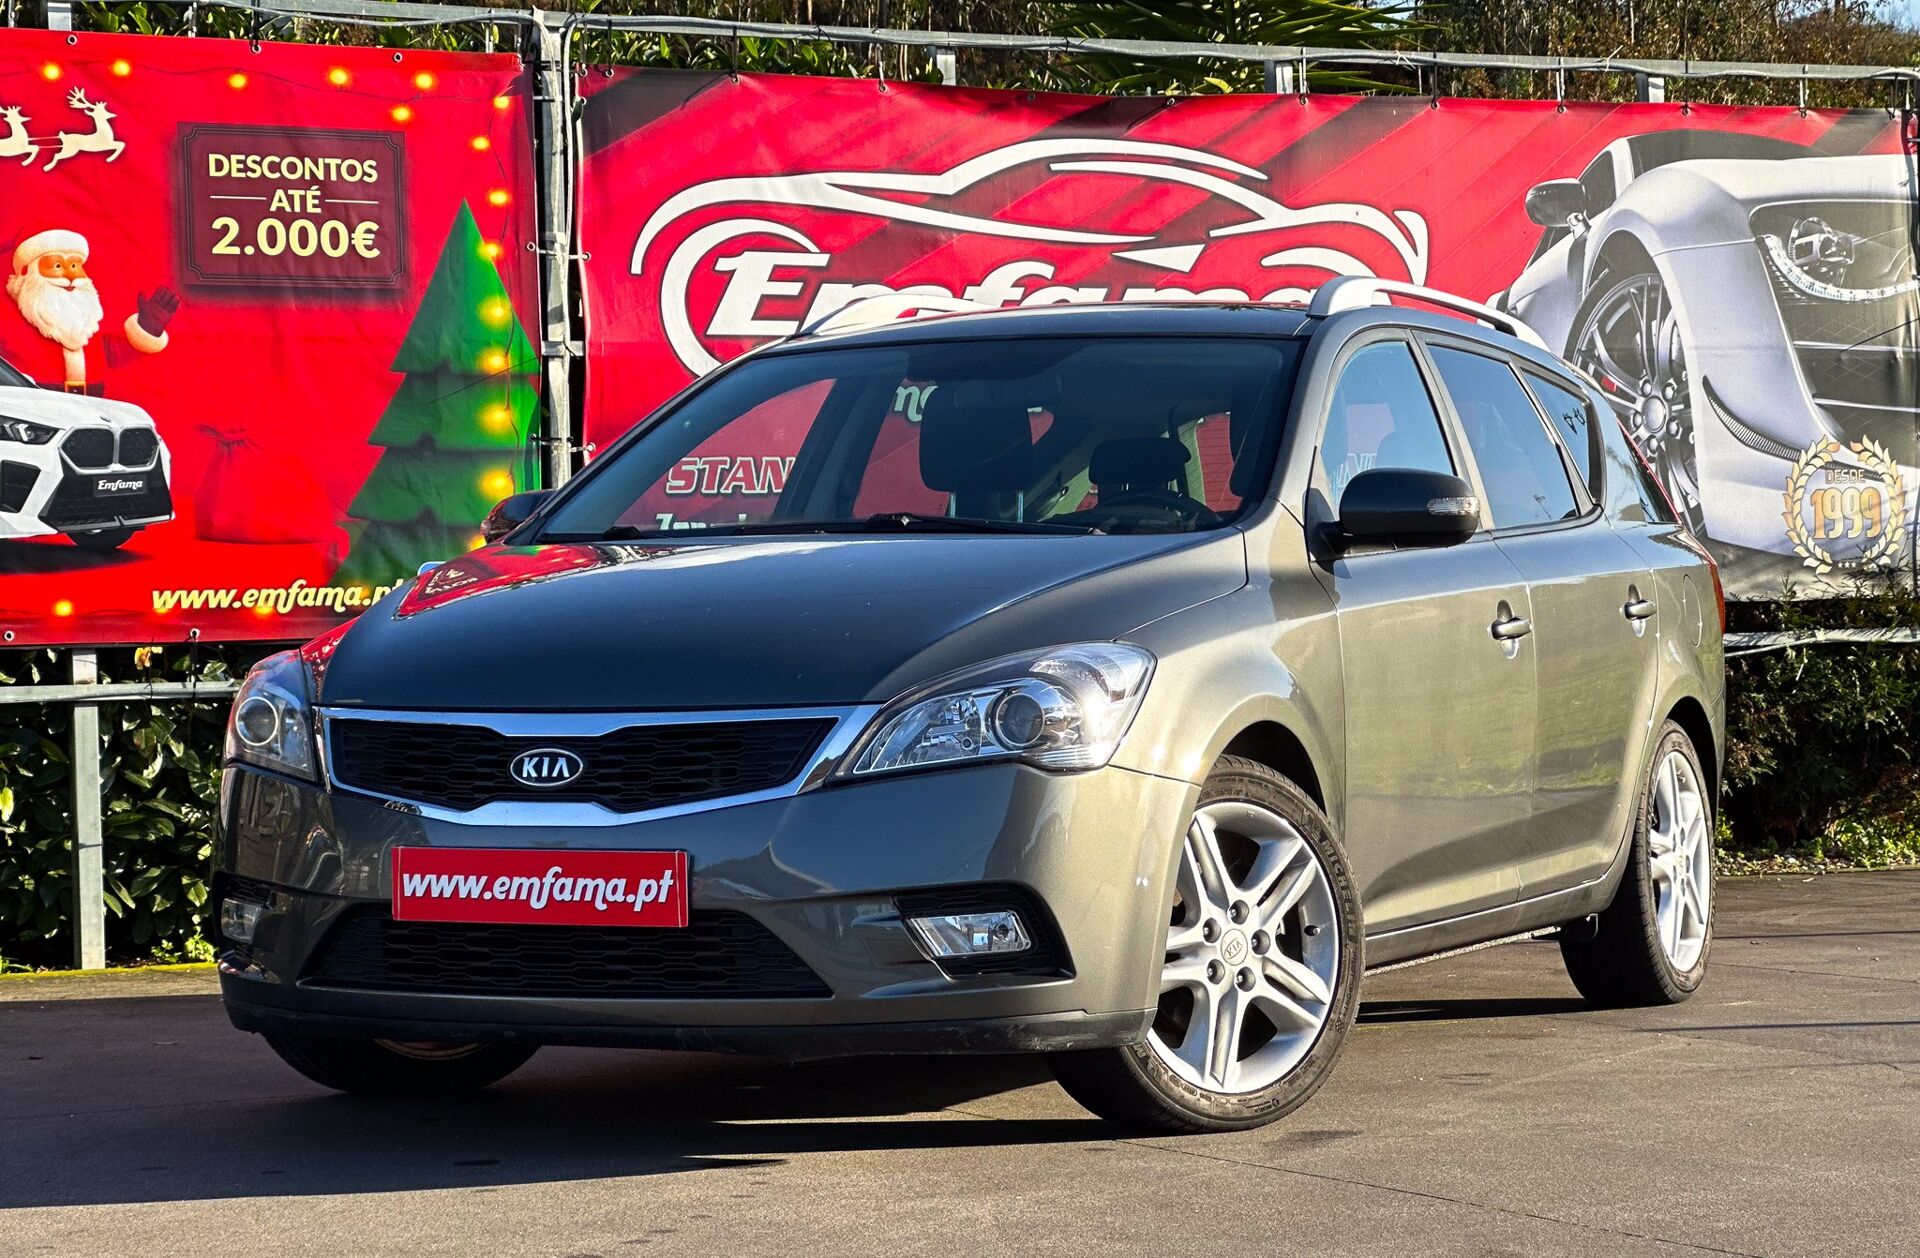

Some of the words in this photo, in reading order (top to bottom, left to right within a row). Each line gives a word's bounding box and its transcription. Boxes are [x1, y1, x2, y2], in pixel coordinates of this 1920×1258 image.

[208, 153, 378, 183] DESCONTOS
[269, 185, 322, 213] ATÉ
[211, 216, 381, 258] 2.000€
[97, 479, 144, 492] Emfama
[1825, 469, 1866, 485] DESDE
[1810, 486, 1882, 539] 1999
[521, 756, 570, 778] KIA
[402, 865, 674, 912] www.emfama.pt
[1226, 940, 1243, 957] KIA
